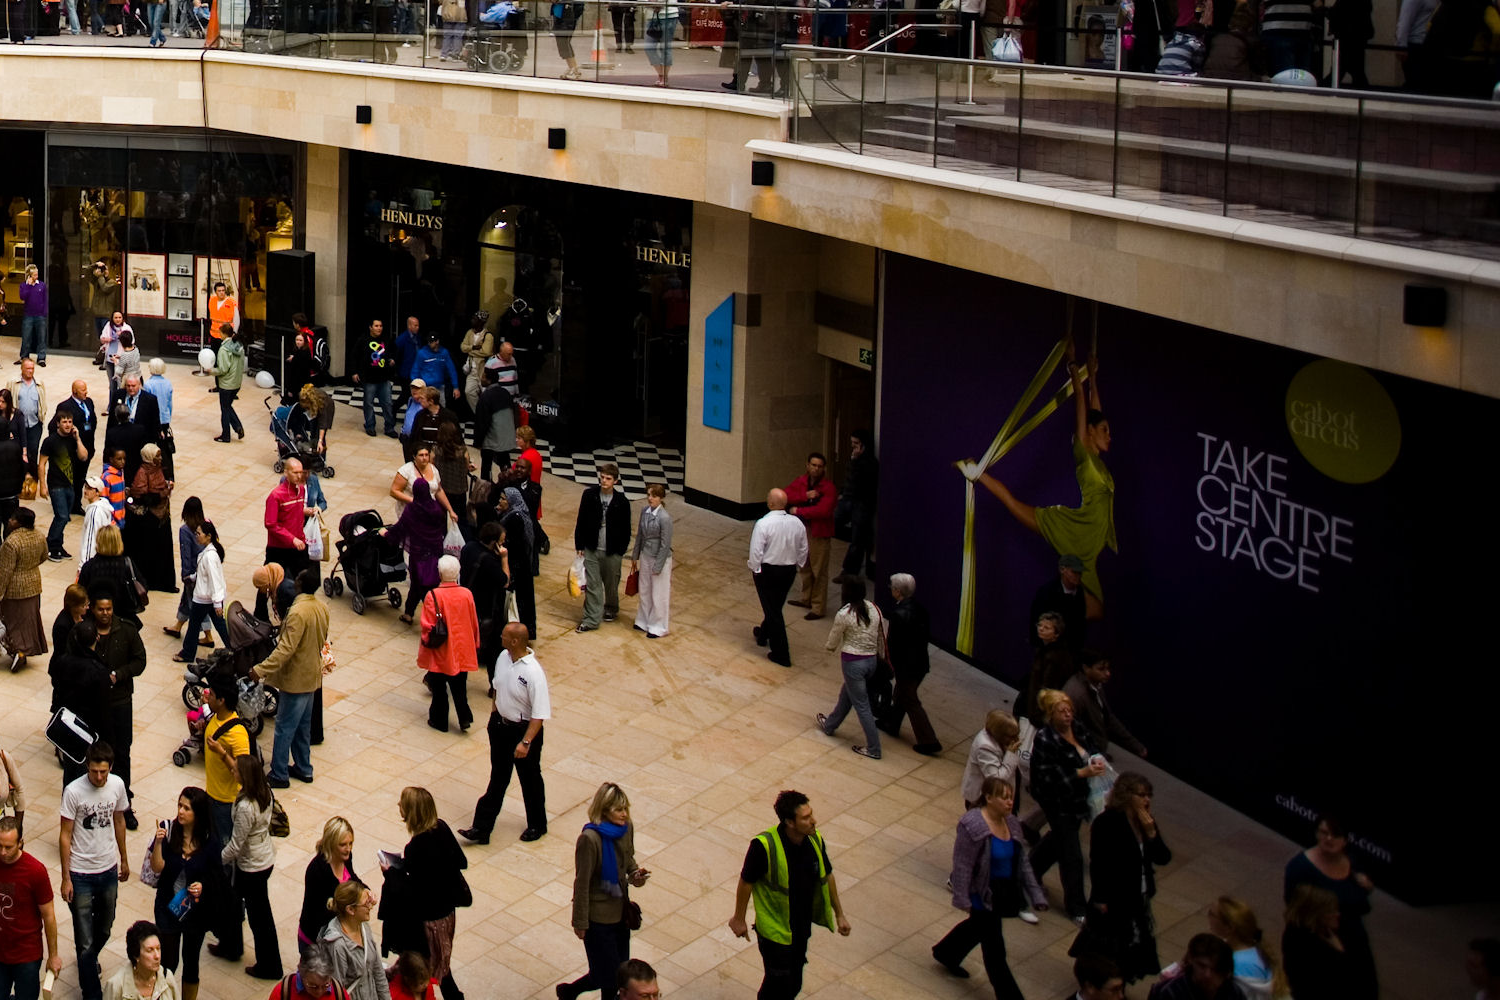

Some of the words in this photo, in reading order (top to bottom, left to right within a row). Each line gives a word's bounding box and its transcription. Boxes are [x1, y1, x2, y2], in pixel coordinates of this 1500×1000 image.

[380, 208, 443, 230] HENLEYS
[635, 245, 690, 269] HENLE
[166, 333, 193, 343] HOUSE
[1290, 400, 1355, 433] cabot
[1290, 416, 1360, 451] circus
[1197, 431, 1289, 498] TAKE
[1196, 474, 1354, 563] CENTRE
[1194, 511, 1320, 593] STAGE
